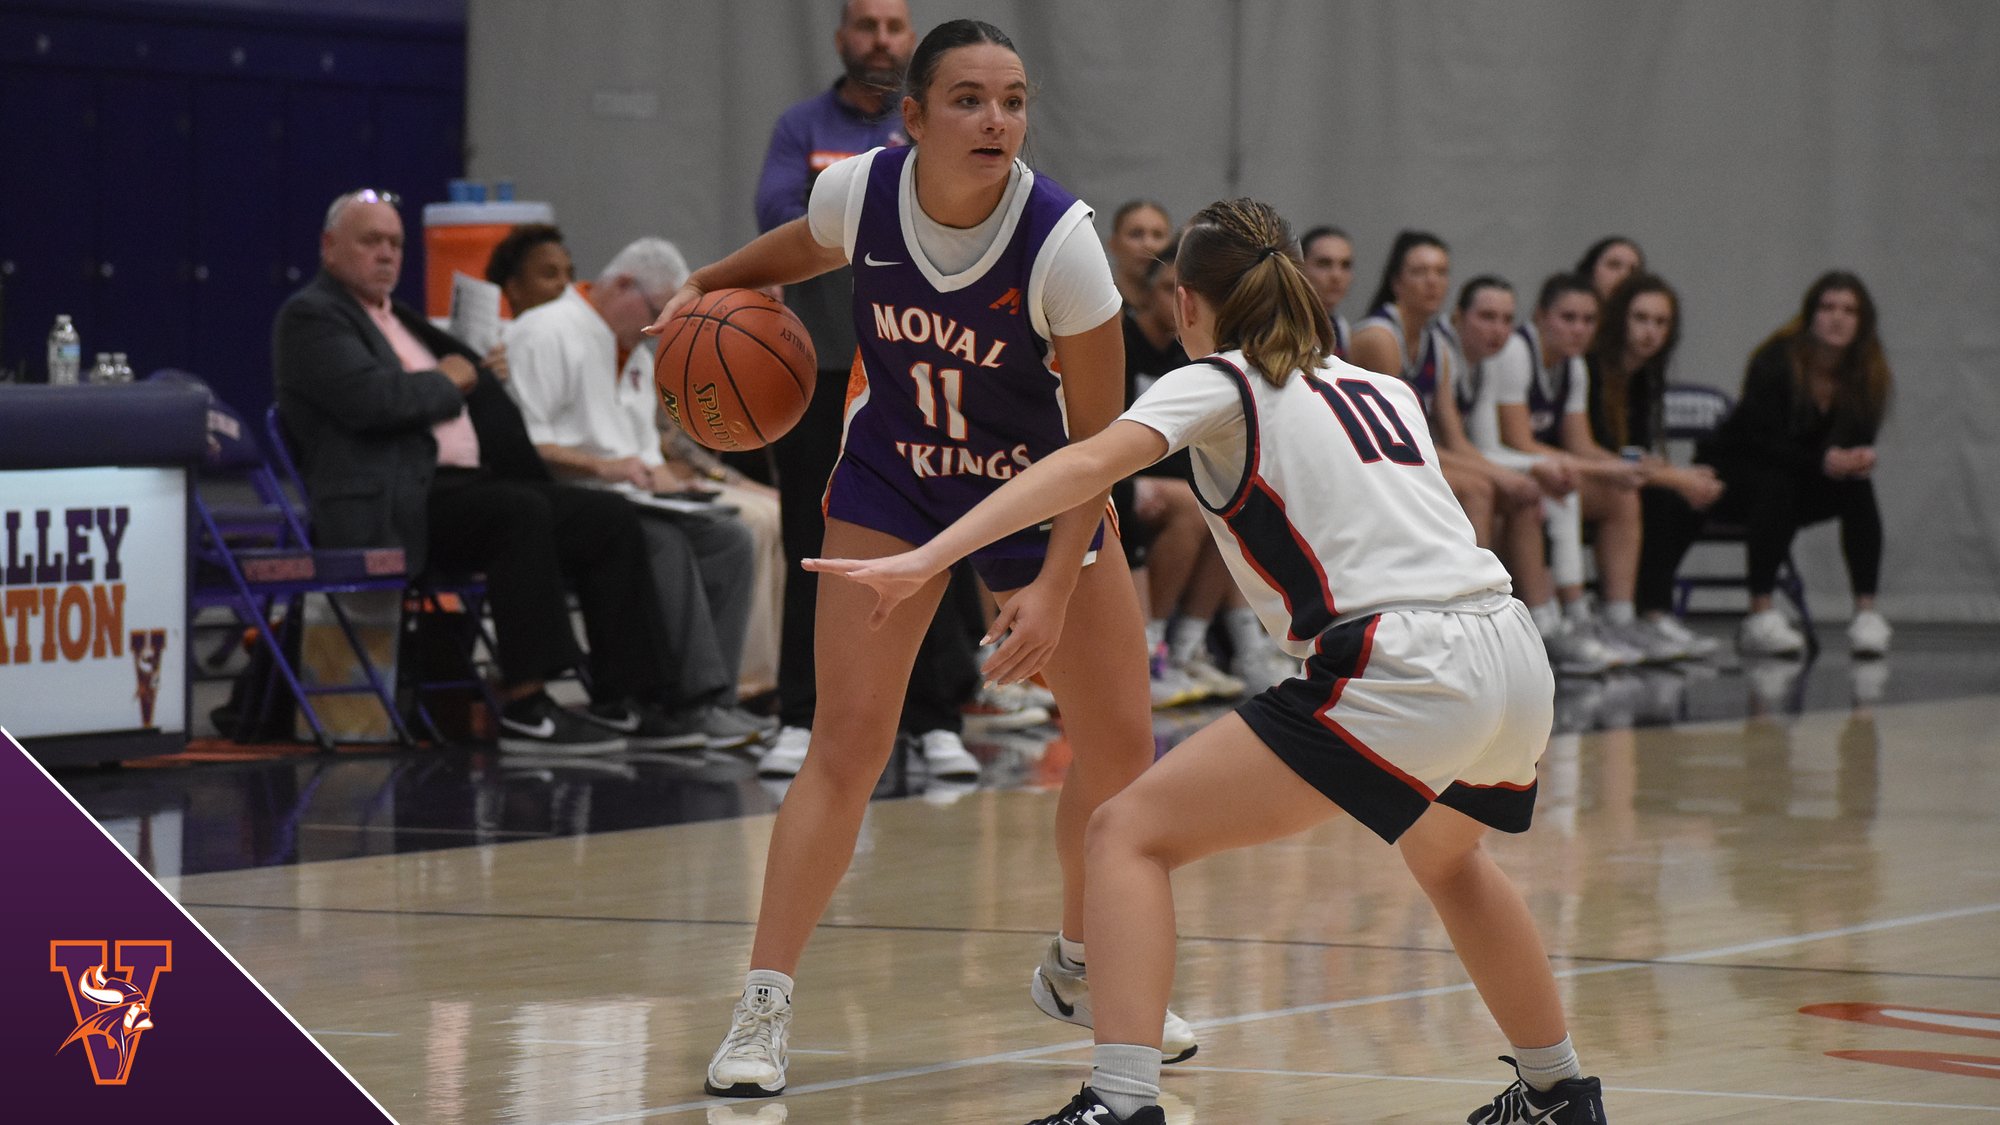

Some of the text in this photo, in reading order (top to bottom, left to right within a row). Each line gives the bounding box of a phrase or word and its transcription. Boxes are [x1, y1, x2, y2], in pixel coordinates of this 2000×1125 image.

[872, 303, 1008, 368] MOVAL
[909, 361, 968, 441] 11
[1300, 374, 1425, 466] 10
[895, 440, 1034, 480] KINGS
[0, 507, 129, 585] LLEY
[0, 583, 126, 666] TION
